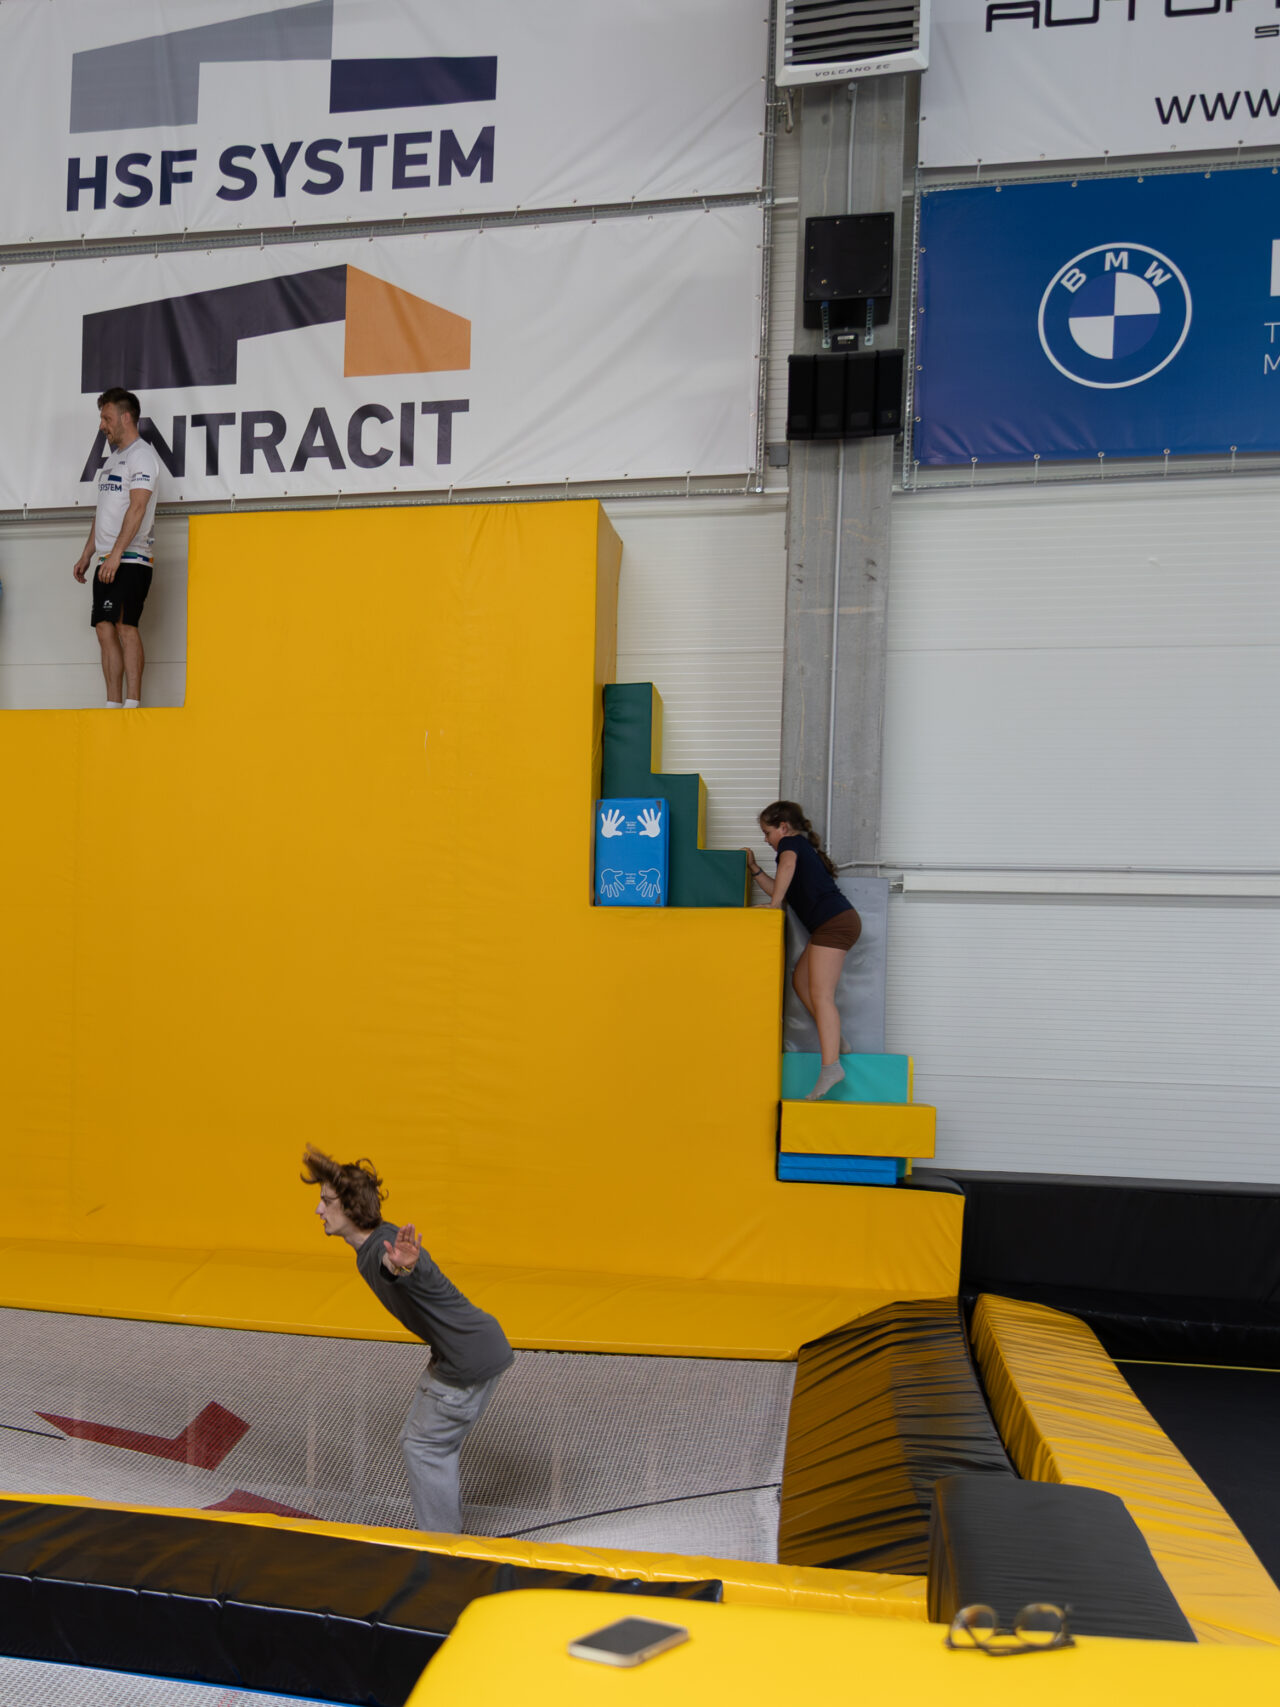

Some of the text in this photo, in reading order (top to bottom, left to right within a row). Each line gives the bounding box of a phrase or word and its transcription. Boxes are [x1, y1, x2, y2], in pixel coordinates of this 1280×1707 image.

[815, 65, 872, 77] VOLCANO
[66, 125, 495, 212] HSF SYSTEM
[1060, 251, 1173, 294] BMW
